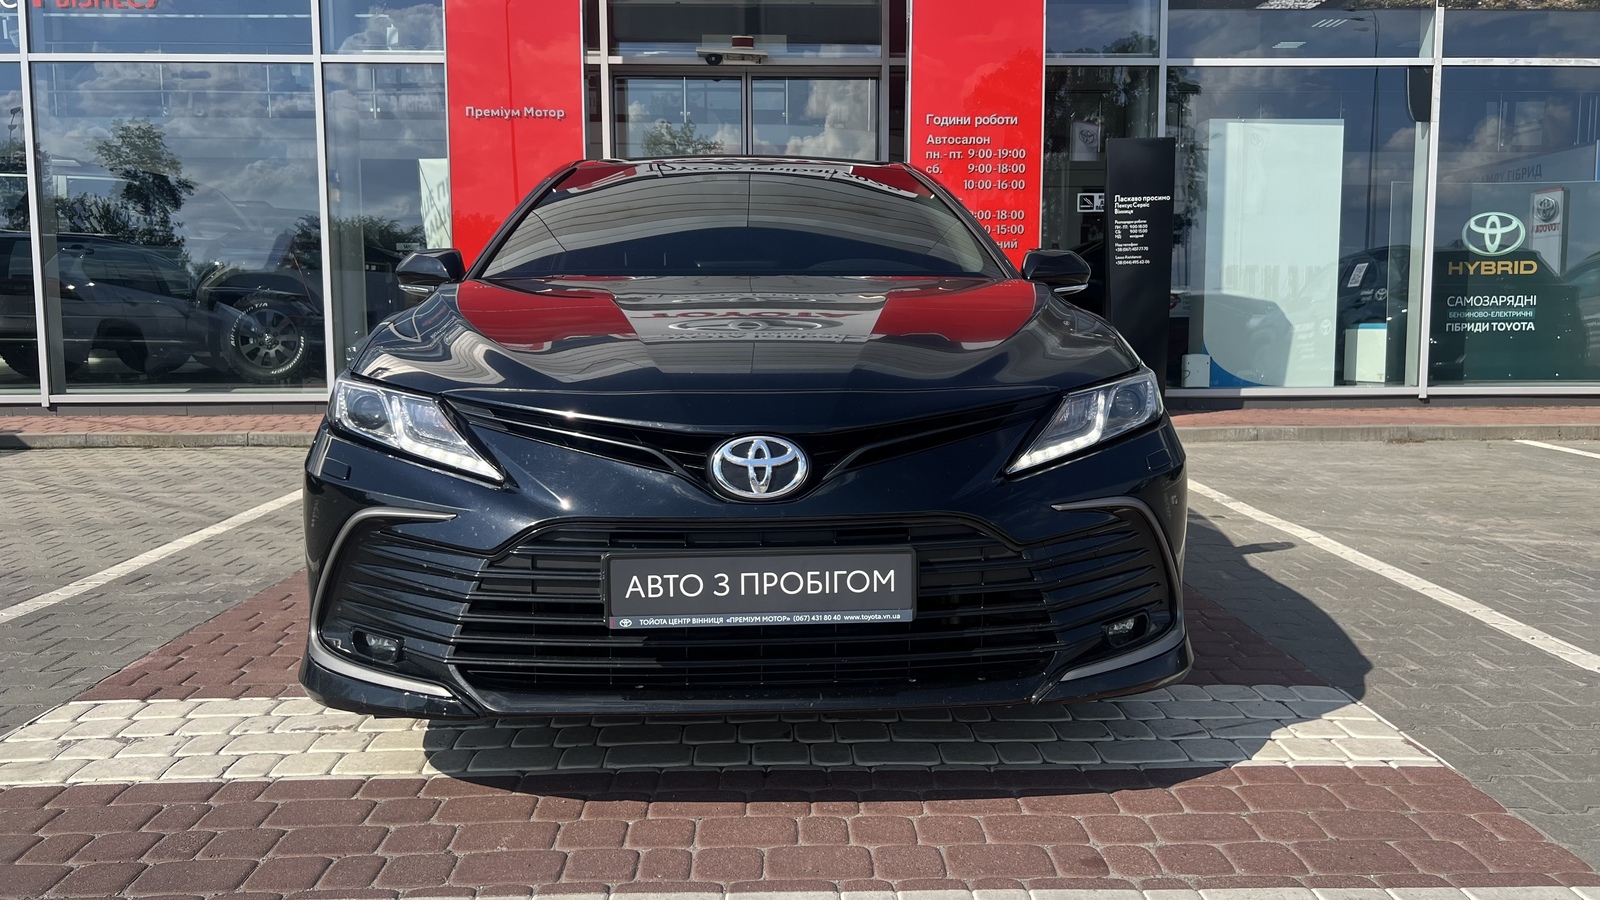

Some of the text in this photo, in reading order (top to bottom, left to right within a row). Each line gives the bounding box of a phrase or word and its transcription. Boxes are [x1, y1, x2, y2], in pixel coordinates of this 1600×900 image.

[465, 106, 565, 119] Преміум Мотор
[926, 114, 1018, 127] Години роботи
[926, 134, 991, 145] Автосалон
[967, 149, 1026, 159] 9:00-19:00
[925, 163, 1026, 174] сб. 9:00-18:00
[1507, 164, 1543, 182] ГІБРИД
[963, 179, 1026, 190] 10:00-16:00
[1142, 195, 1171, 203] просимо
[1447, 260, 1538, 276] HYBRID
[1446, 294, 1537, 308] САМОЗАРЯДНІ
[1448, 309, 1534, 319] БЕНЗИНОВО-ЕЛЕКТРИЧНІ
[1445, 321, 1536, 333] ГІБРИДИ TOYOTA
[625, 569, 895, 599] АВТО З ПРОБІГОМ
[639, 617, 667, 626] ТОЙОТА
[668, 618, 691, 626] ЦЕНТР
[692, 617, 723, 625] ВІННИЦЯ
[726, 615, 761, 624] «ПРЕМІУМ
[762, 615, 790, 623] МОТОР»
[793, 614, 810, 623] (067)
[811, 614, 823, 622] 431
[843, 613, 901, 621] www.toyota.vn.ua
